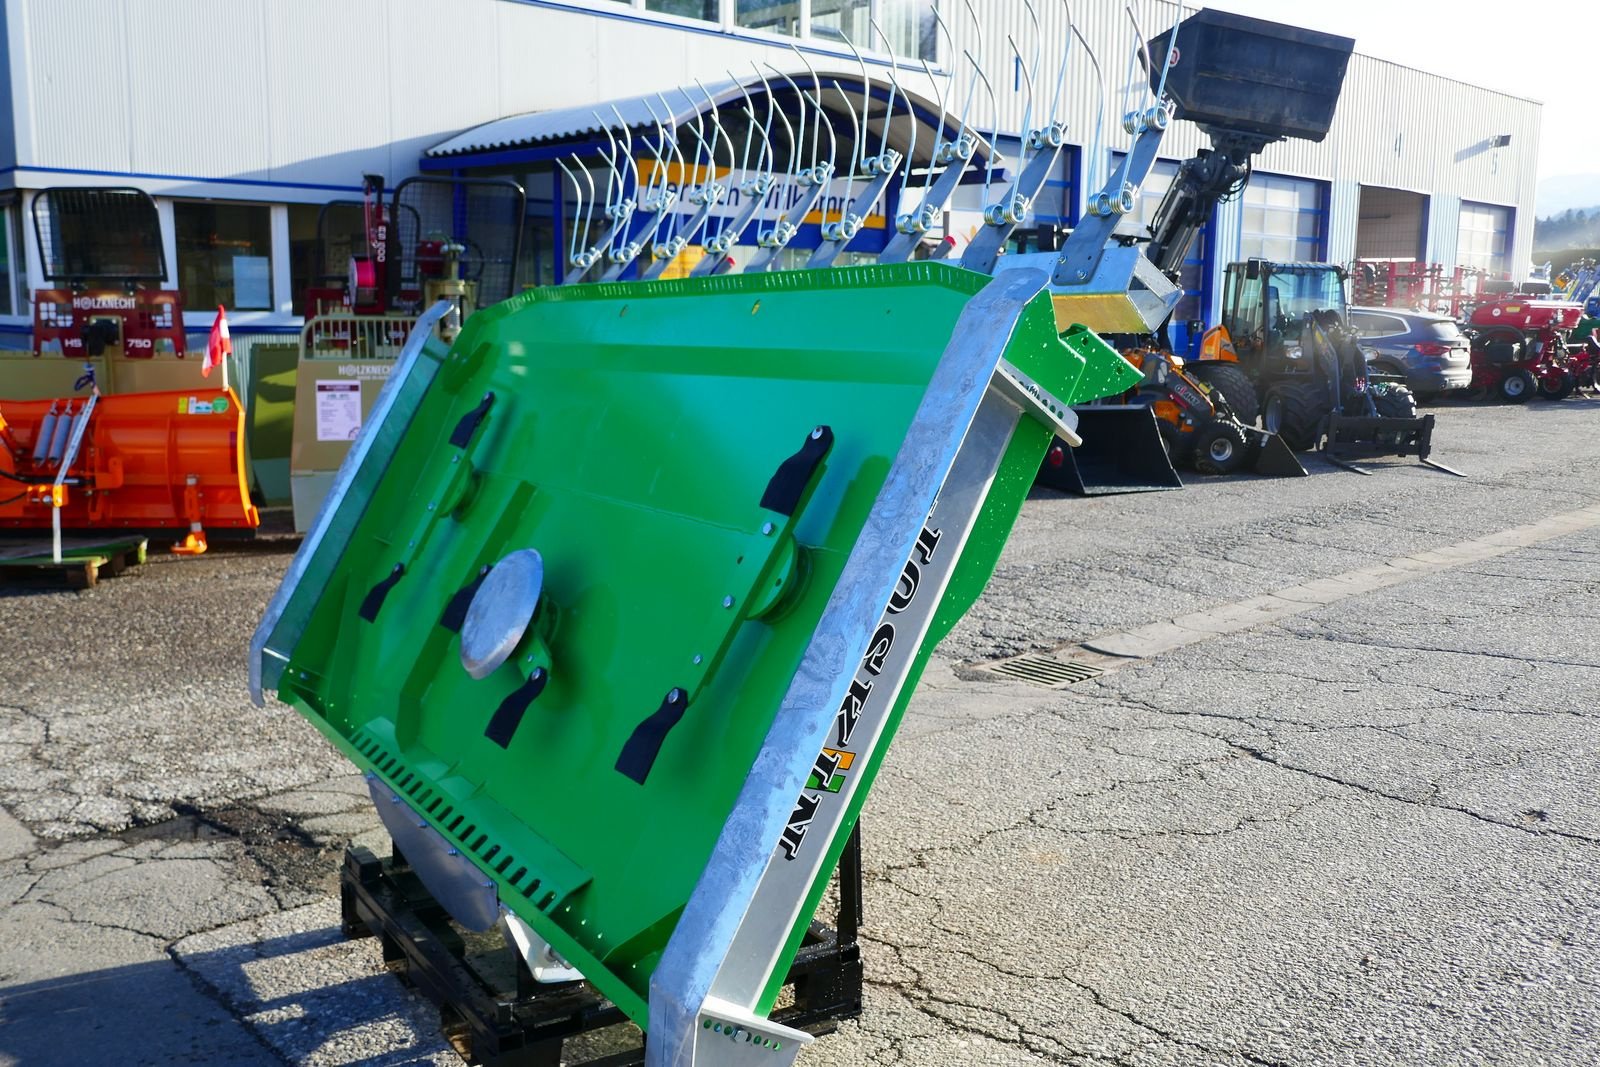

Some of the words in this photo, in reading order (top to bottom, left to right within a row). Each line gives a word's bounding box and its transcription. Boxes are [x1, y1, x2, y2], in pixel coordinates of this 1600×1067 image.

[73, 297, 136, 310] HOLZKNECHT
[64, 338, 83, 348] HS
[127, 338, 152, 349] 750
